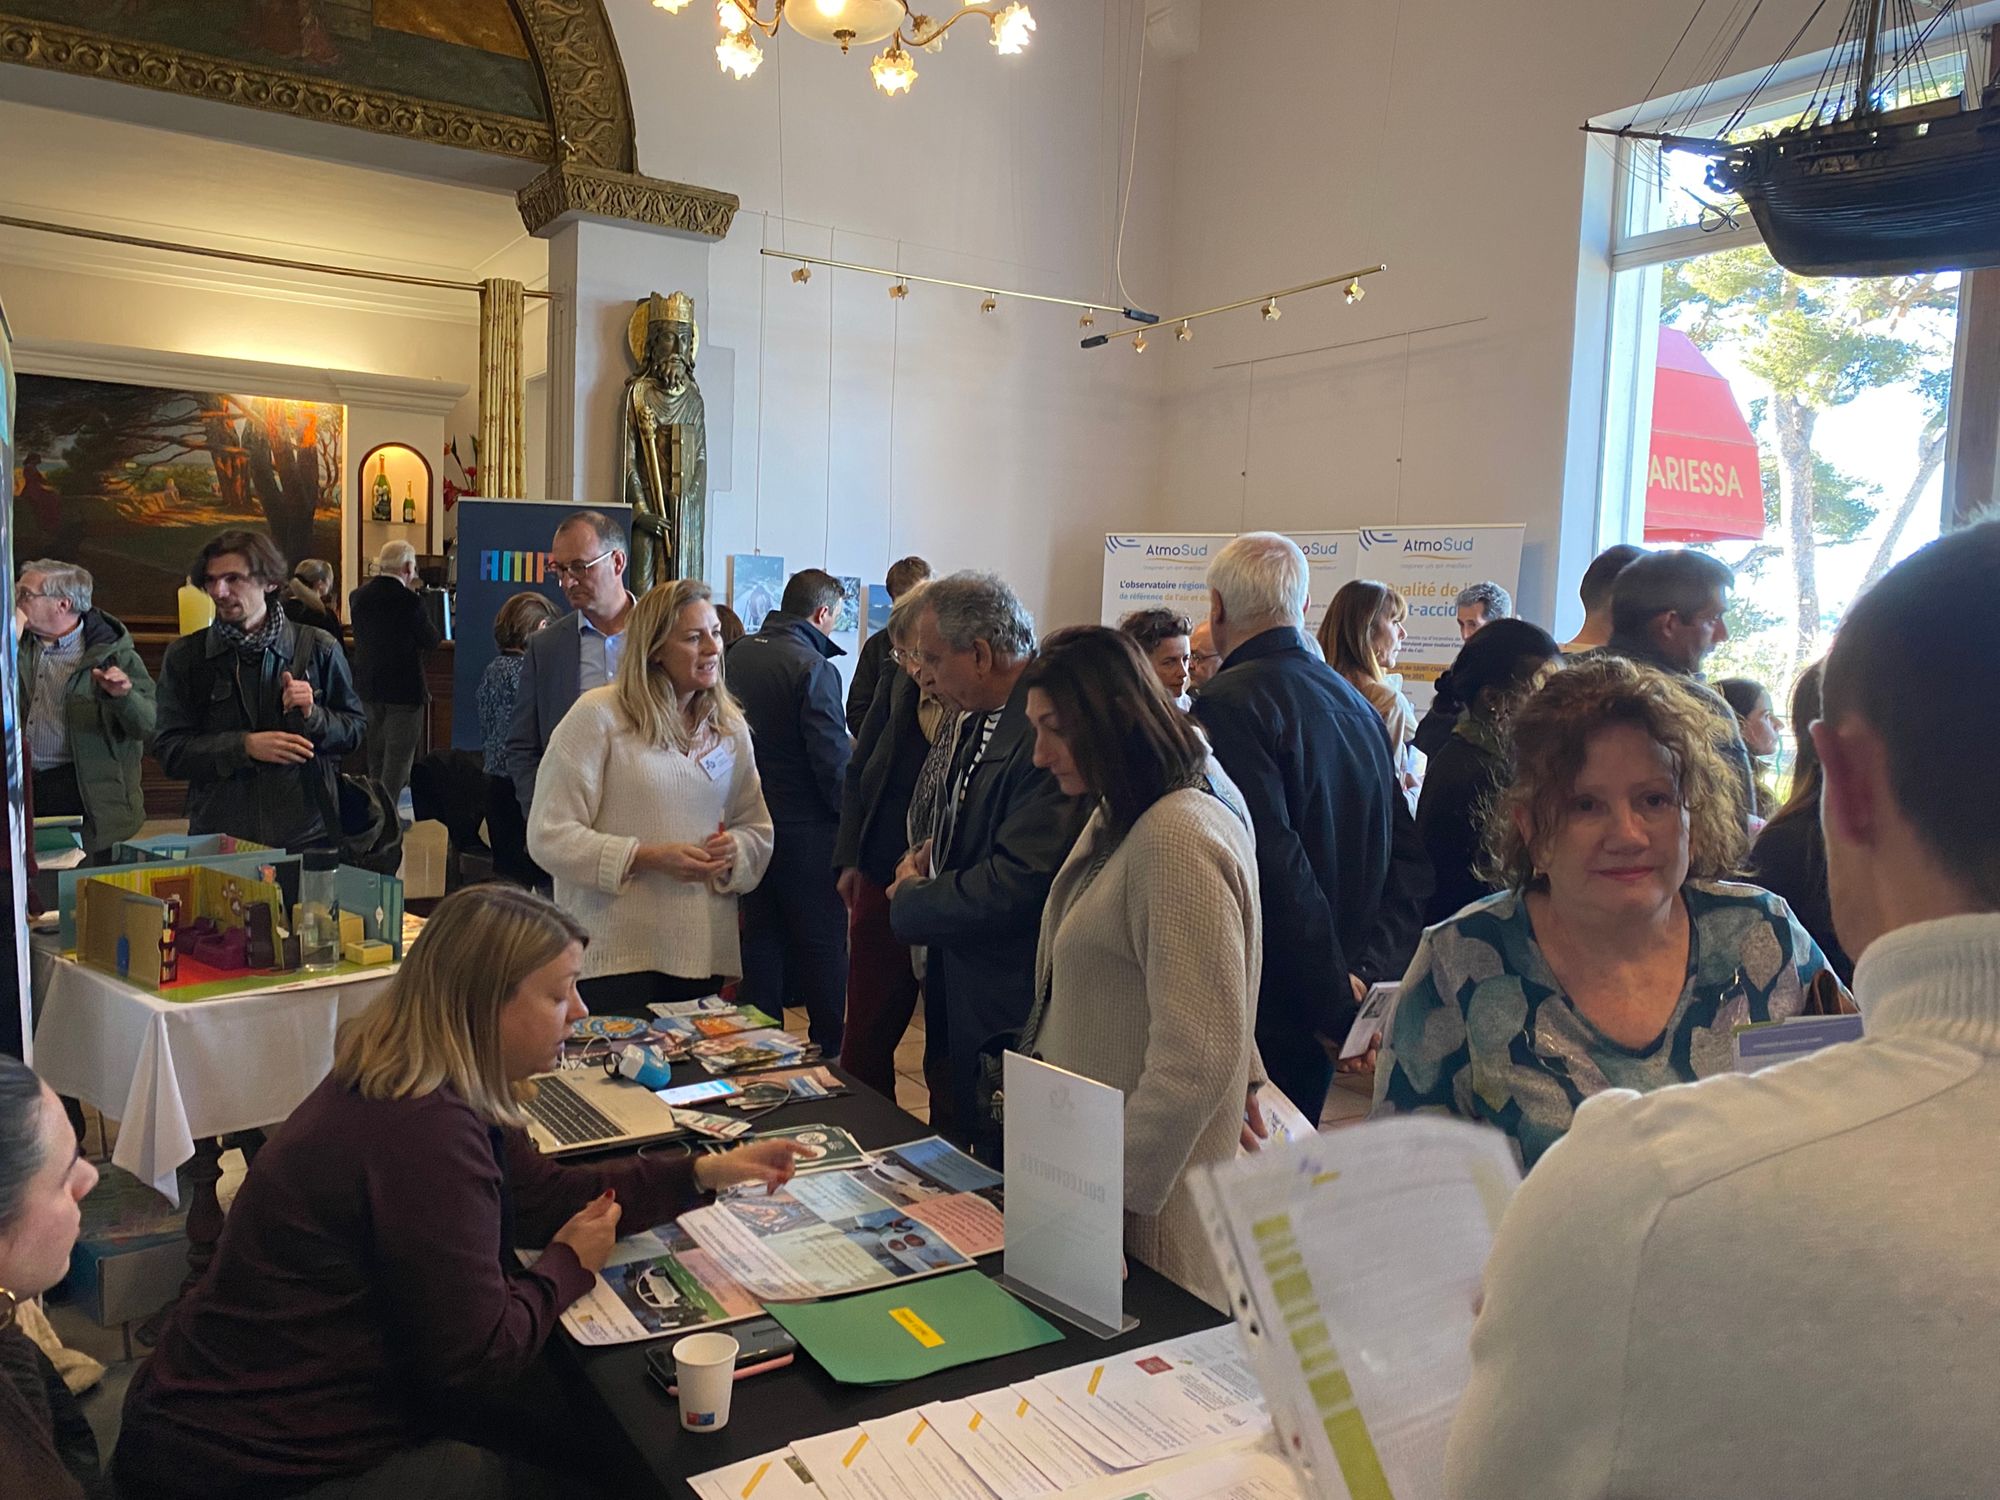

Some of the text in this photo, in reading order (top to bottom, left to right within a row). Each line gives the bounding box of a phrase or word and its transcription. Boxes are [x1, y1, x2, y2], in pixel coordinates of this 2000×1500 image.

[1648, 454, 1744, 498] ARIESSA
[1146, 544, 1208, 556] AtmoSud
[1299, 542, 1338, 555] oSud
[1403, 537, 1474, 552] AtmoSud
[1120, 580, 1177, 590] L'observatoire
[1440, 582, 1459, 597] de
